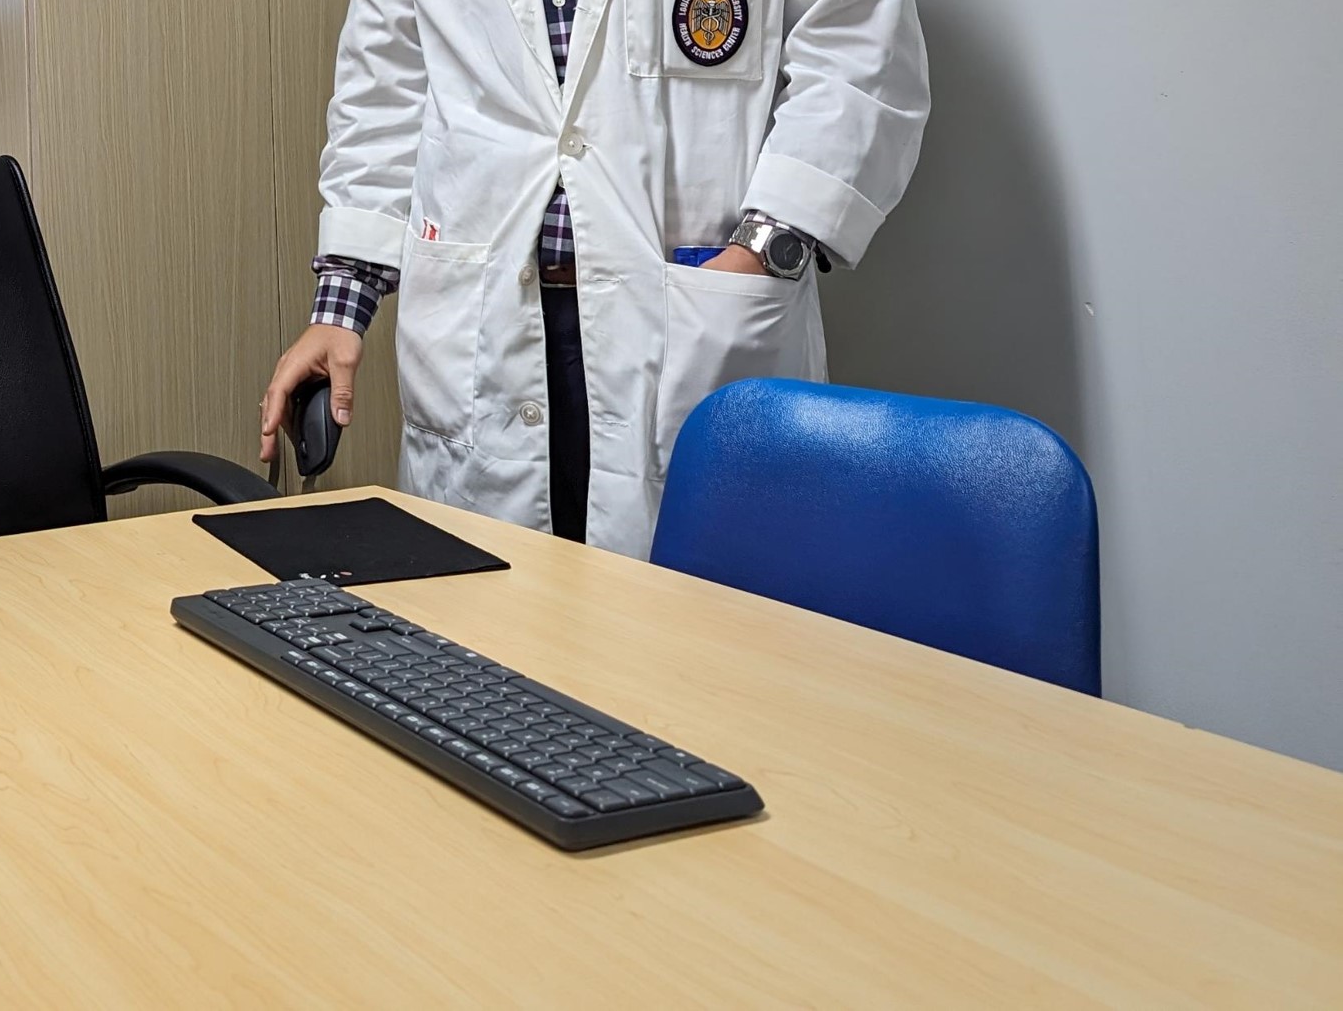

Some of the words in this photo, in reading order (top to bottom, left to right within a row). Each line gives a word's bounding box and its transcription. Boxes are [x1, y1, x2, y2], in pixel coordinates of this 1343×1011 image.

[679, 23, 693, 47] HEALTH
[691, 45, 724, 60] SCIENCES
[722, 26, 741, 52] CENTER
